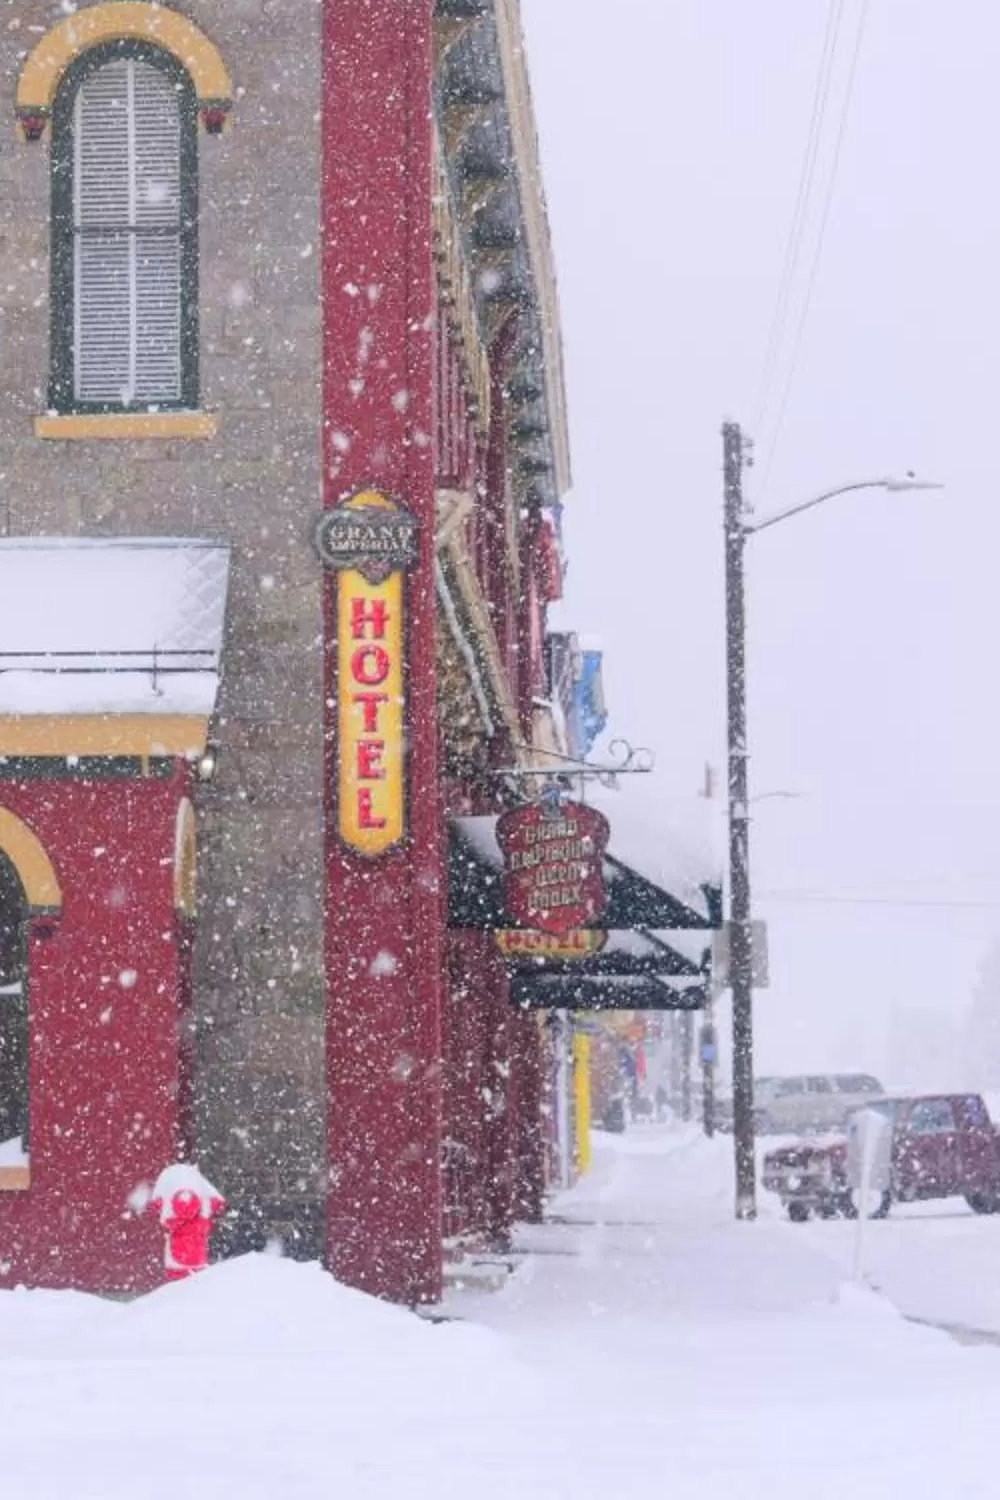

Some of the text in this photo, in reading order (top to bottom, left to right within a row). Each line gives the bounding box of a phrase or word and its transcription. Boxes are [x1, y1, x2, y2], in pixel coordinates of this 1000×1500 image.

[329, 525, 413, 539] GRAND
[351, 597, 390, 829] HOTEL
[525, 819, 578, 844] GRAND
